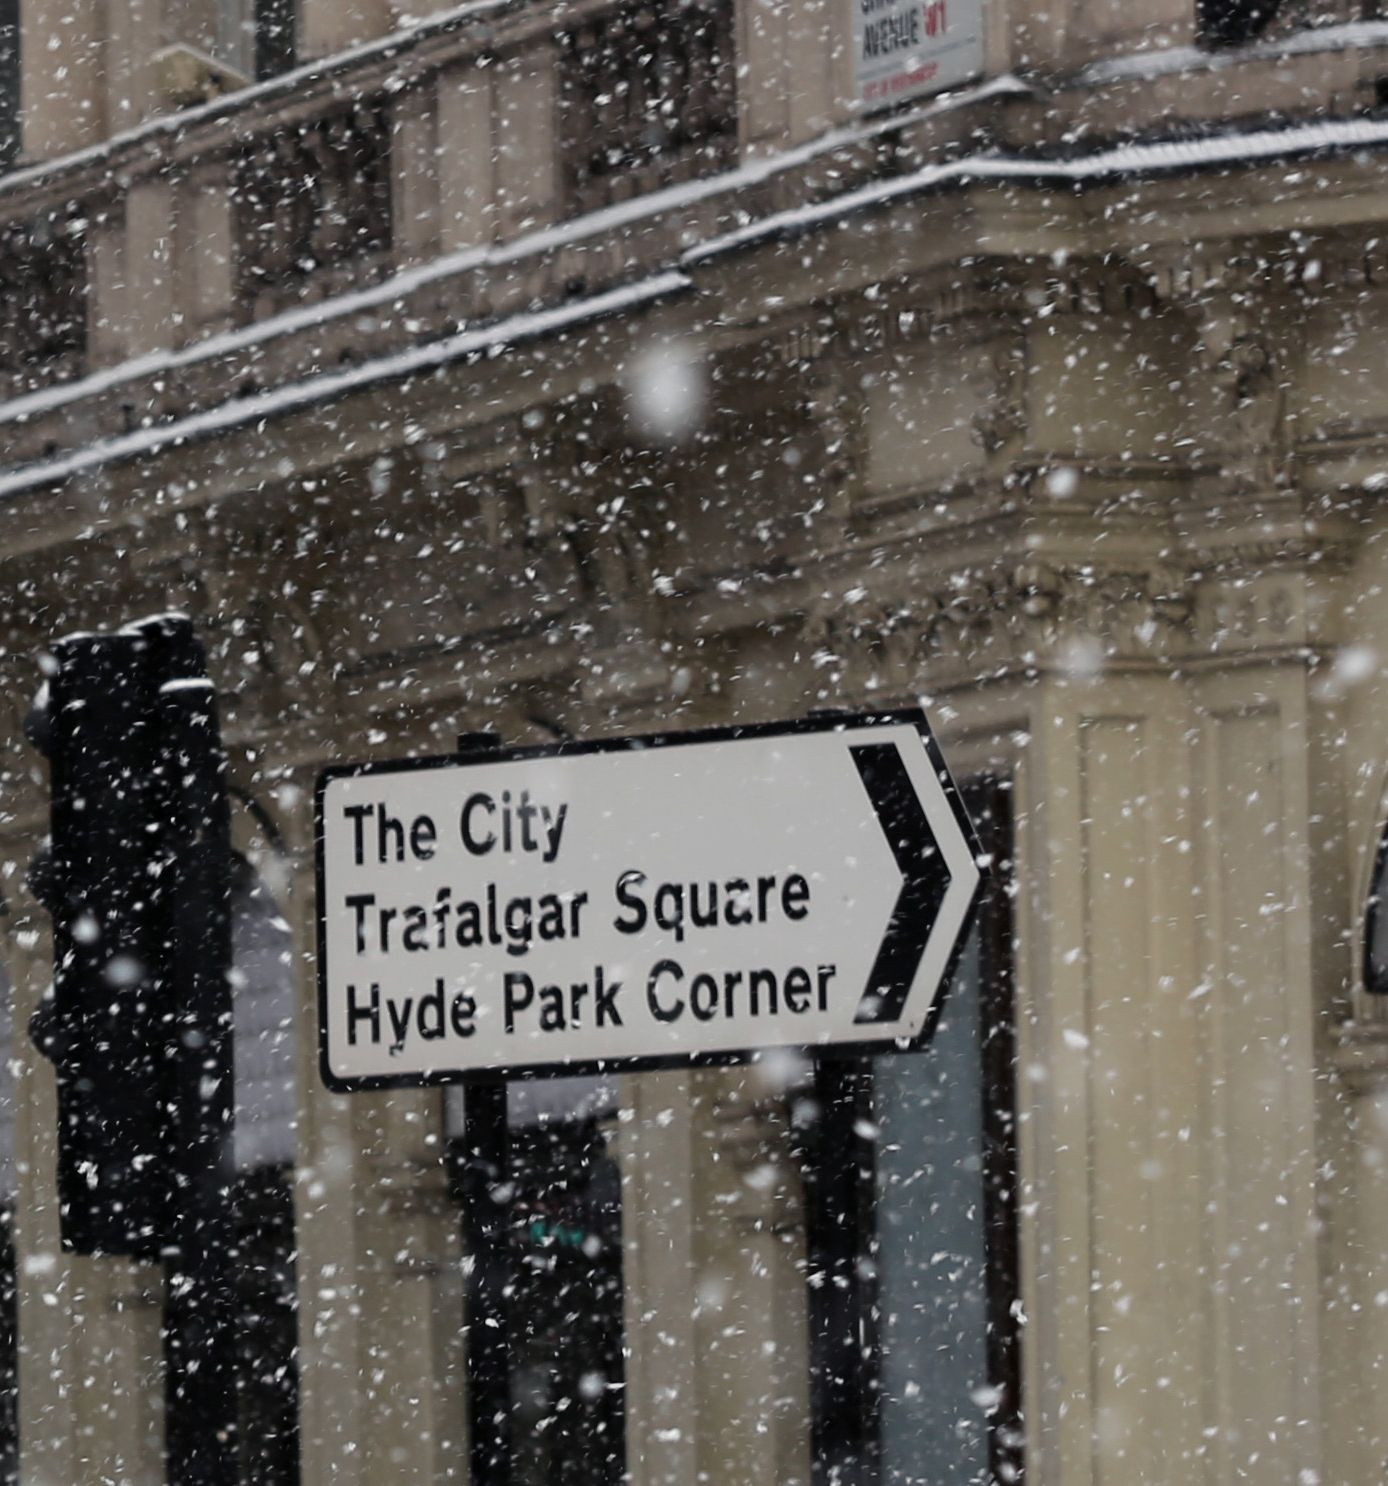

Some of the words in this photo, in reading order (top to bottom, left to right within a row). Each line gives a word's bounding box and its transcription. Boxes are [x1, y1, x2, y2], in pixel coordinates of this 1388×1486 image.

[863, 8, 919, 60] AVENUE
[344, 803, 437, 865] The
[460, 790, 568, 862] City
[345, 881, 589, 955] Trafalgar
[614, 869, 811, 941] Square
[346, 977, 476, 1056] Hyde
[503, 967, 623, 1034] Park
[646, 959, 837, 1022] Corner
